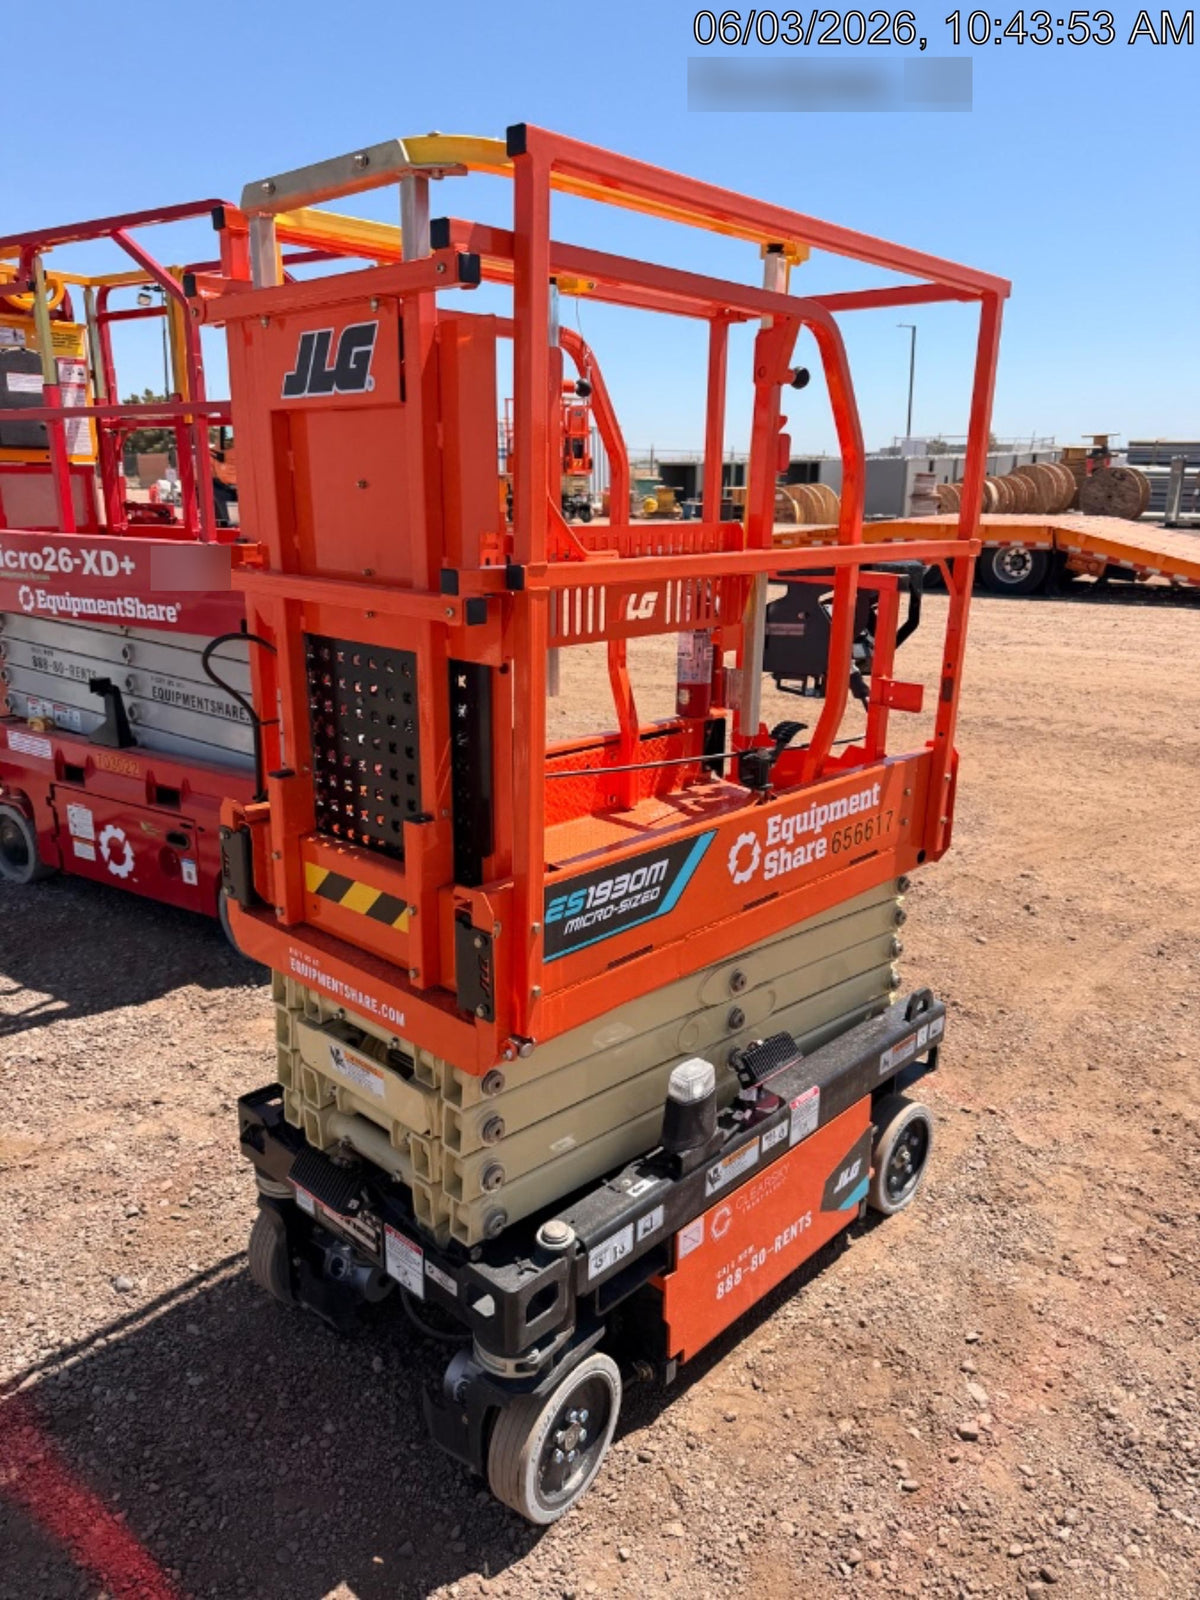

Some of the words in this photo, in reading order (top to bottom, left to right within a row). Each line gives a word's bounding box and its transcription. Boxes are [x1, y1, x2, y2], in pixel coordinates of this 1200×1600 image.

[763, 836, 827, 880] Share
[831, 810, 895, 855] 656617
[766, 782, 881, 846] Equipment
[545, 858, 670, 924] ES1930M
[563, 886, 661, 935] MICRO-SIZED
[289, 957, 406, 1028] EQUIPMENTSHARE.COM
[833, 1158, 862, 1194] JLG
[715, 1210, 812, 1301] 888-80-RENTS
